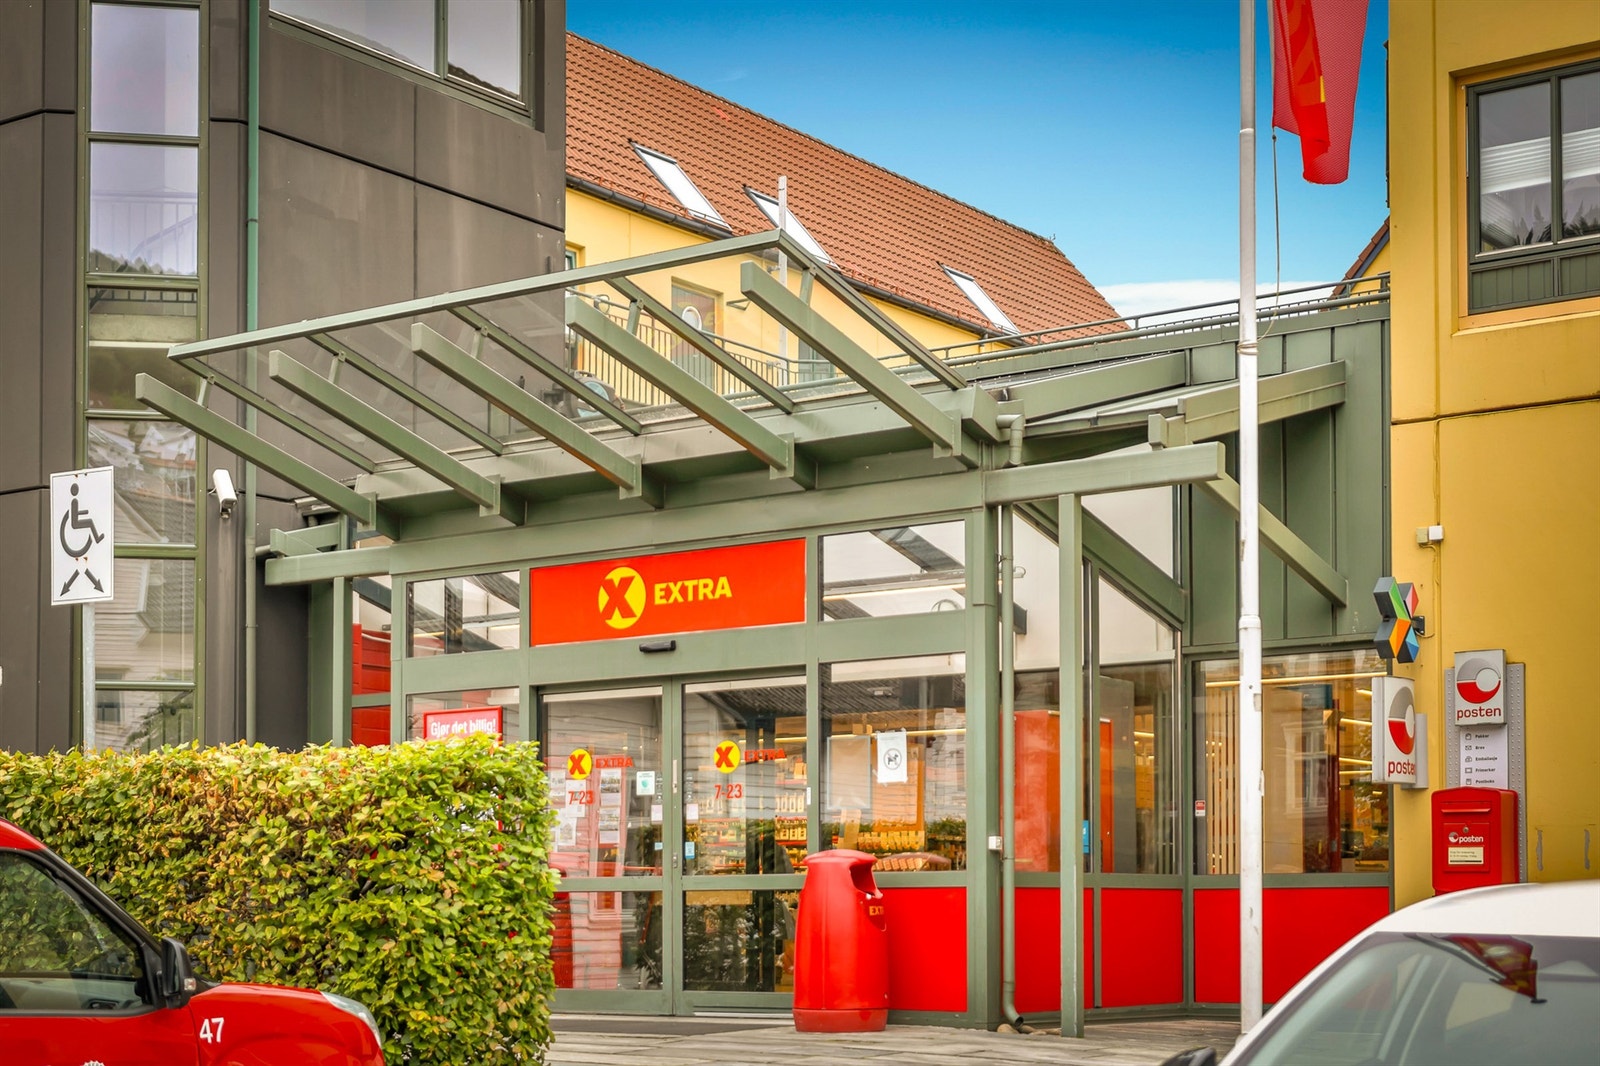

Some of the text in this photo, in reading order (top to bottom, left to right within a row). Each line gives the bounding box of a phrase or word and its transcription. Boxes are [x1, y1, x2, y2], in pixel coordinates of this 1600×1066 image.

[600, 575, 732, 620] X EXTRA
[1456, 706, 1502, 720] posten
[431, 718, 497, 738] Gjør det billig!
[595, 756, 635, 769] EXTRA
[744, 748, 787, 763] EXTRA
[568, 789, 595, 805] 7-23
[714, 783, 743, 800] 7-23
[1459, 835, 1484, 844] posten
[199, 1017, 224, 1044] 47
